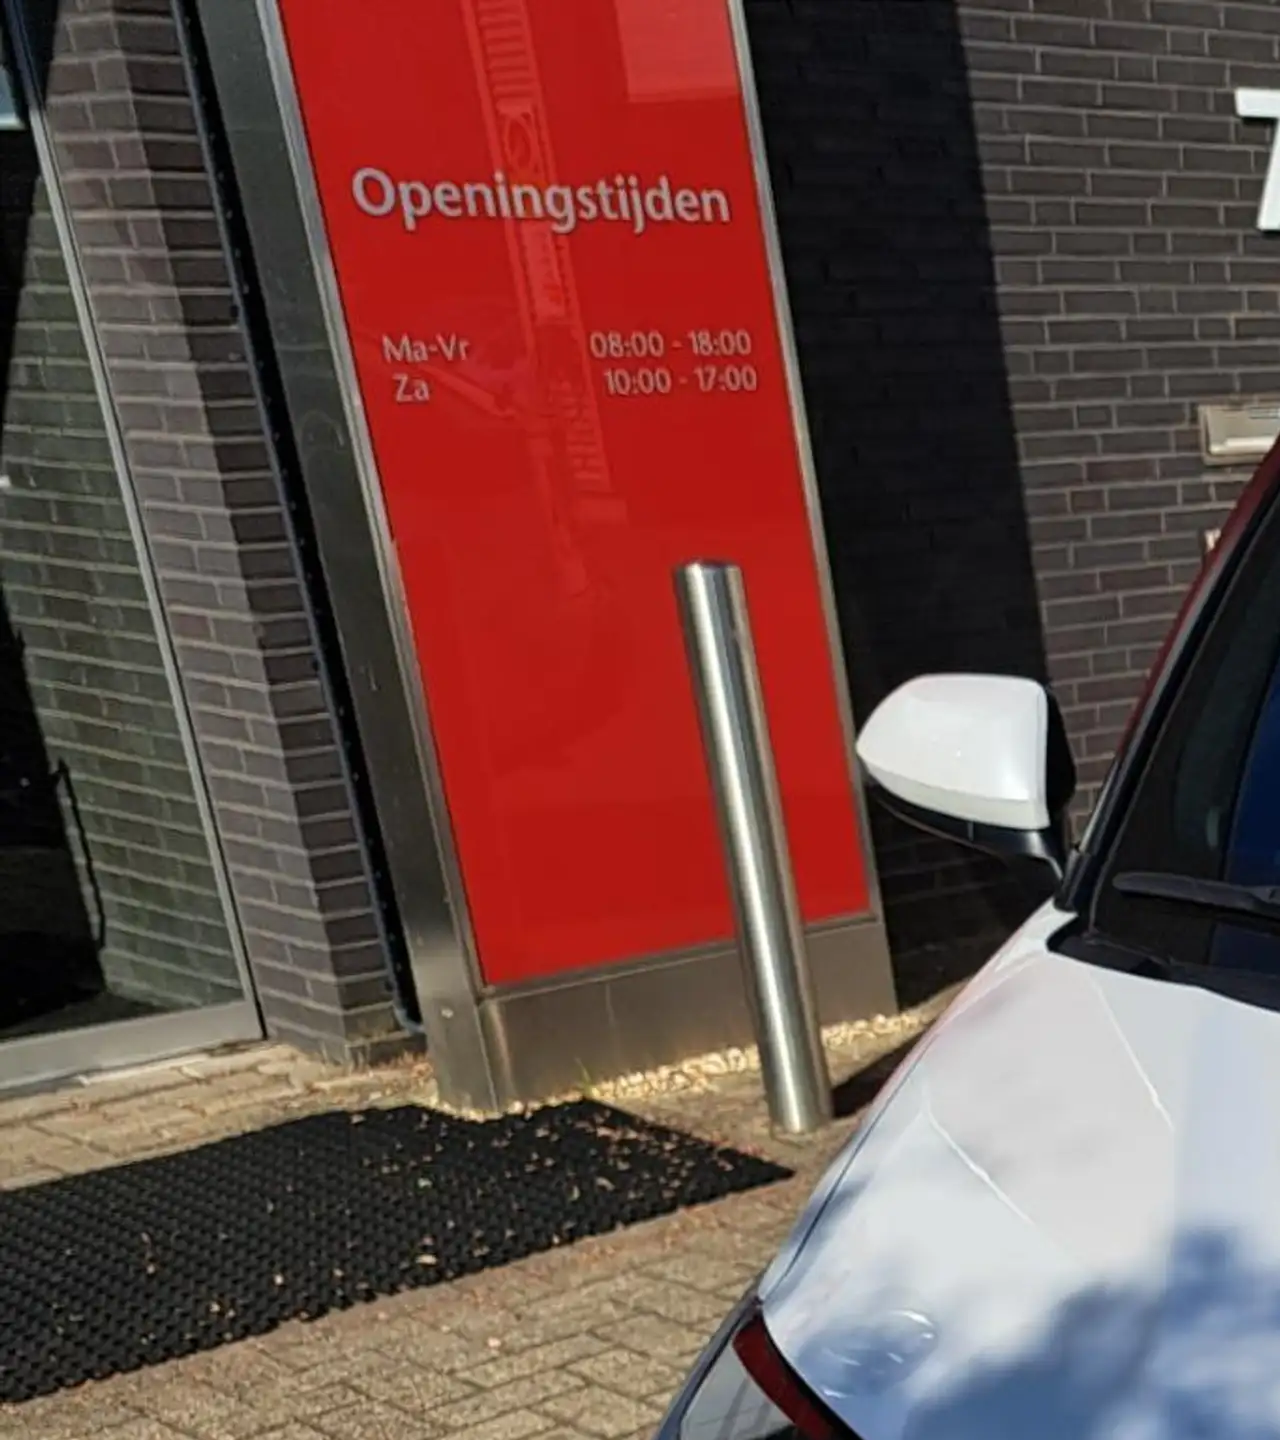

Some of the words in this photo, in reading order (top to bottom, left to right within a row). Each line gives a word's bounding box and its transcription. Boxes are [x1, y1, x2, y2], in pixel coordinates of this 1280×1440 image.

[352, 167, 731, 234] Openingstijden
[382, 332, 473, 362] Ma-Vr
[589, 330, 665, 358] 08:00
[687, 330, 752, 357] 18:00
[393, 373, 430, 402] Za
[604, 367, 672, 396] 10:00
[694, 365, 758, 392] 17:00
